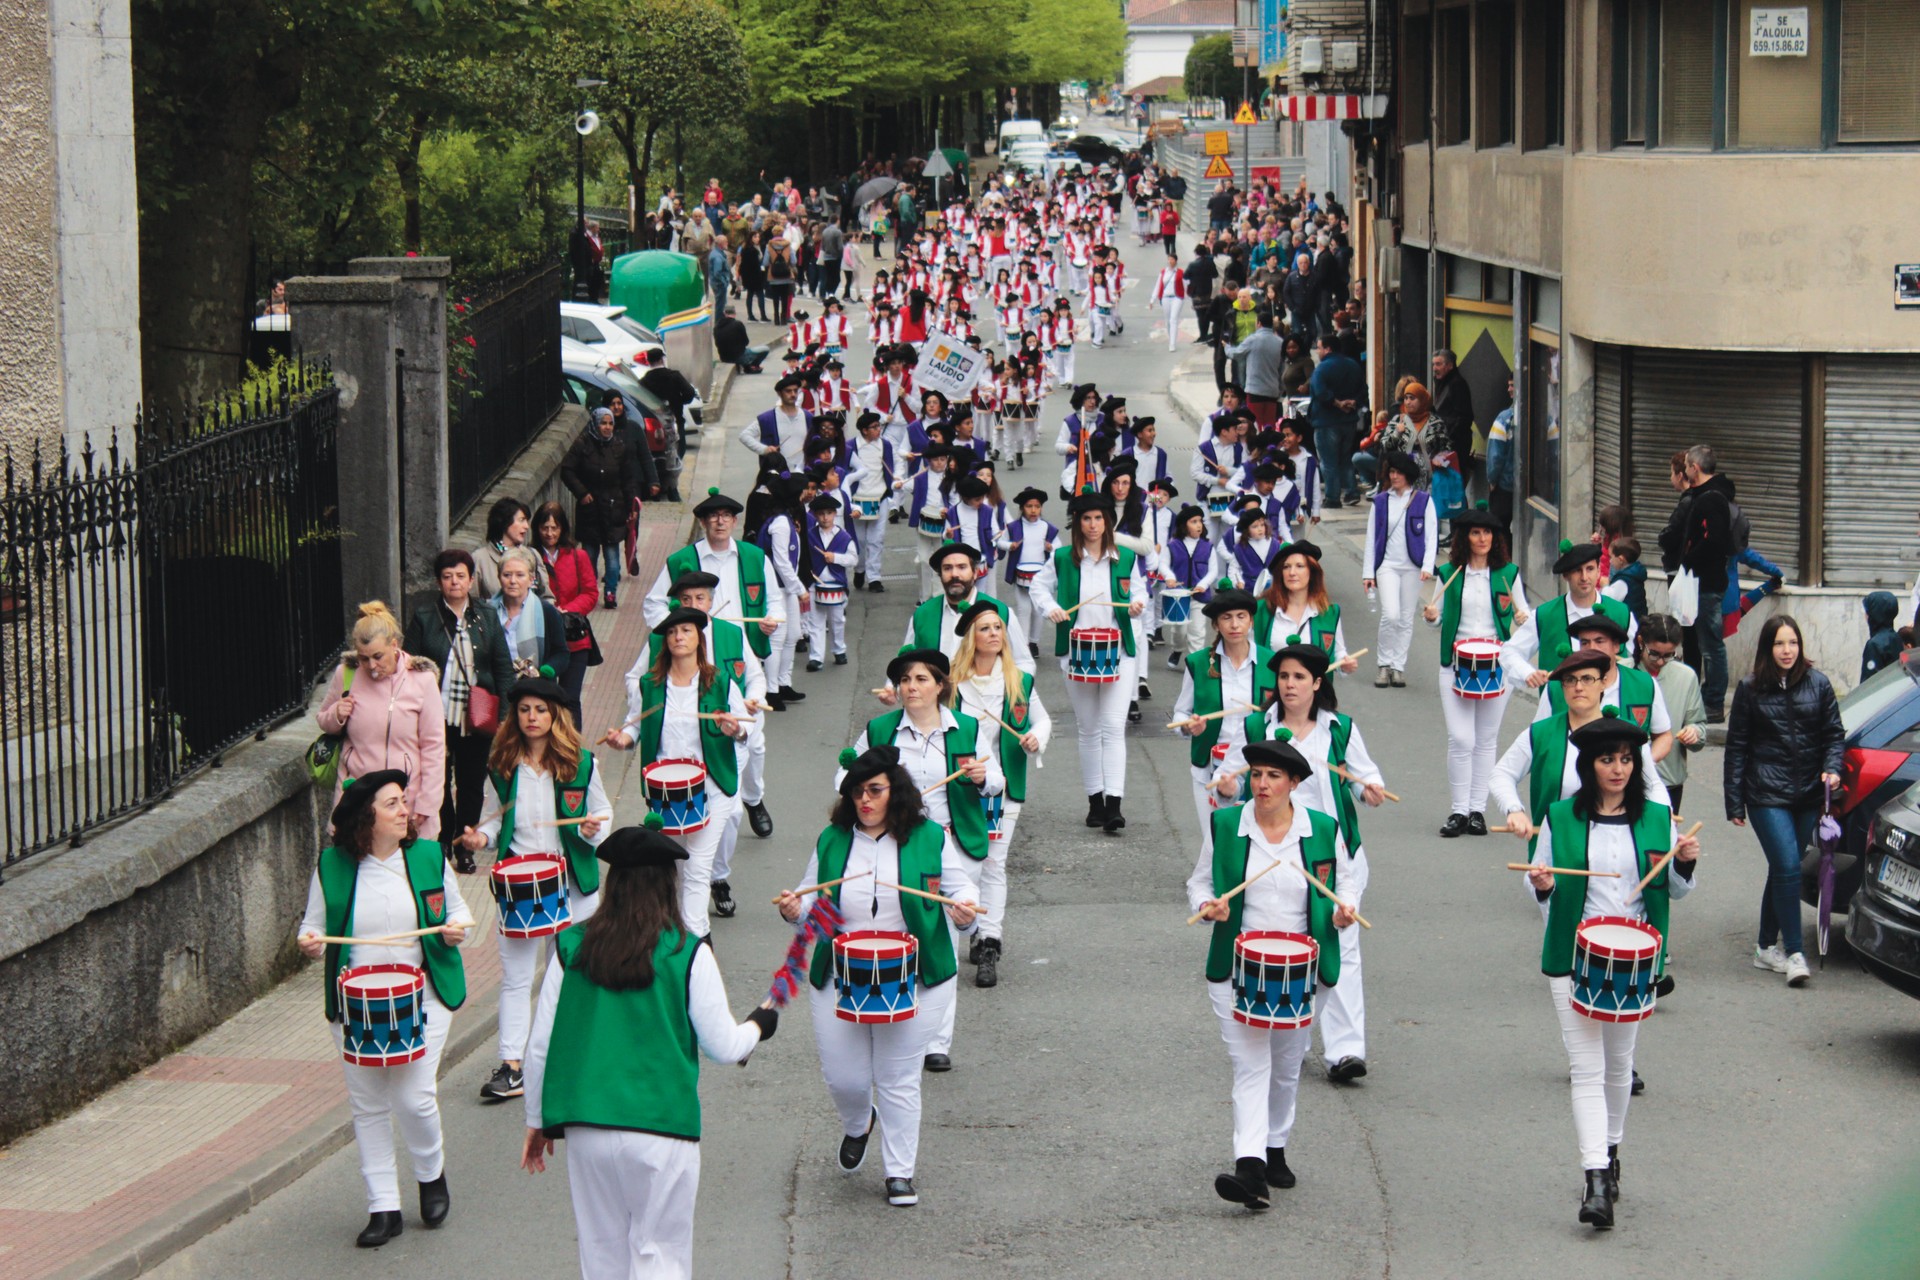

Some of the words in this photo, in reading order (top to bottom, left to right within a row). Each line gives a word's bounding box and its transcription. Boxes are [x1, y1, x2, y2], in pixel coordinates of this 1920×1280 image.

[1777, 16, 1787, 26] SE
[1762, 28, 1801, 38] ALQUILA
[929, 358, 965, 382] LAUDIO
[1885, 860, 1907, 887] 5703
